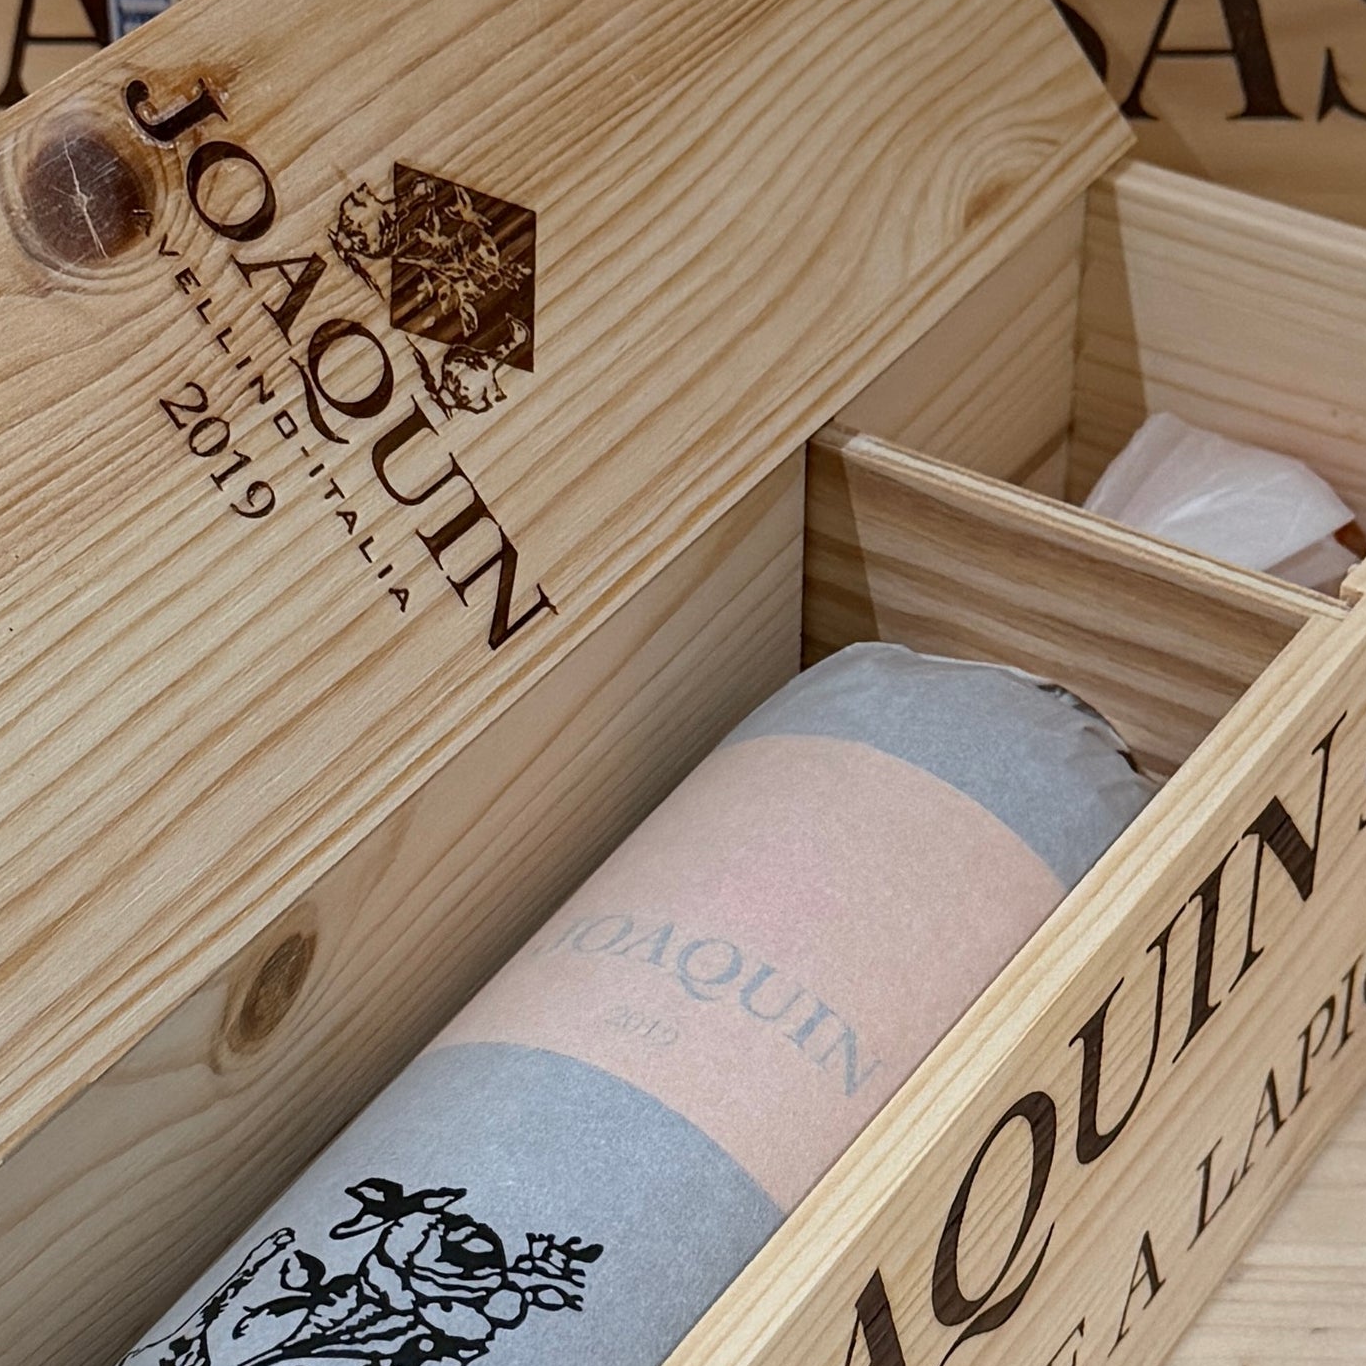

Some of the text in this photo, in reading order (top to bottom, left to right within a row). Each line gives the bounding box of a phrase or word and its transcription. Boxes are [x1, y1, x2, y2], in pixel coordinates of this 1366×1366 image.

[124, 78, 559, 650] JOAQUIN
[159, 381, 277, 519] 2019
[1111, 1232, 1164, 1351] A
